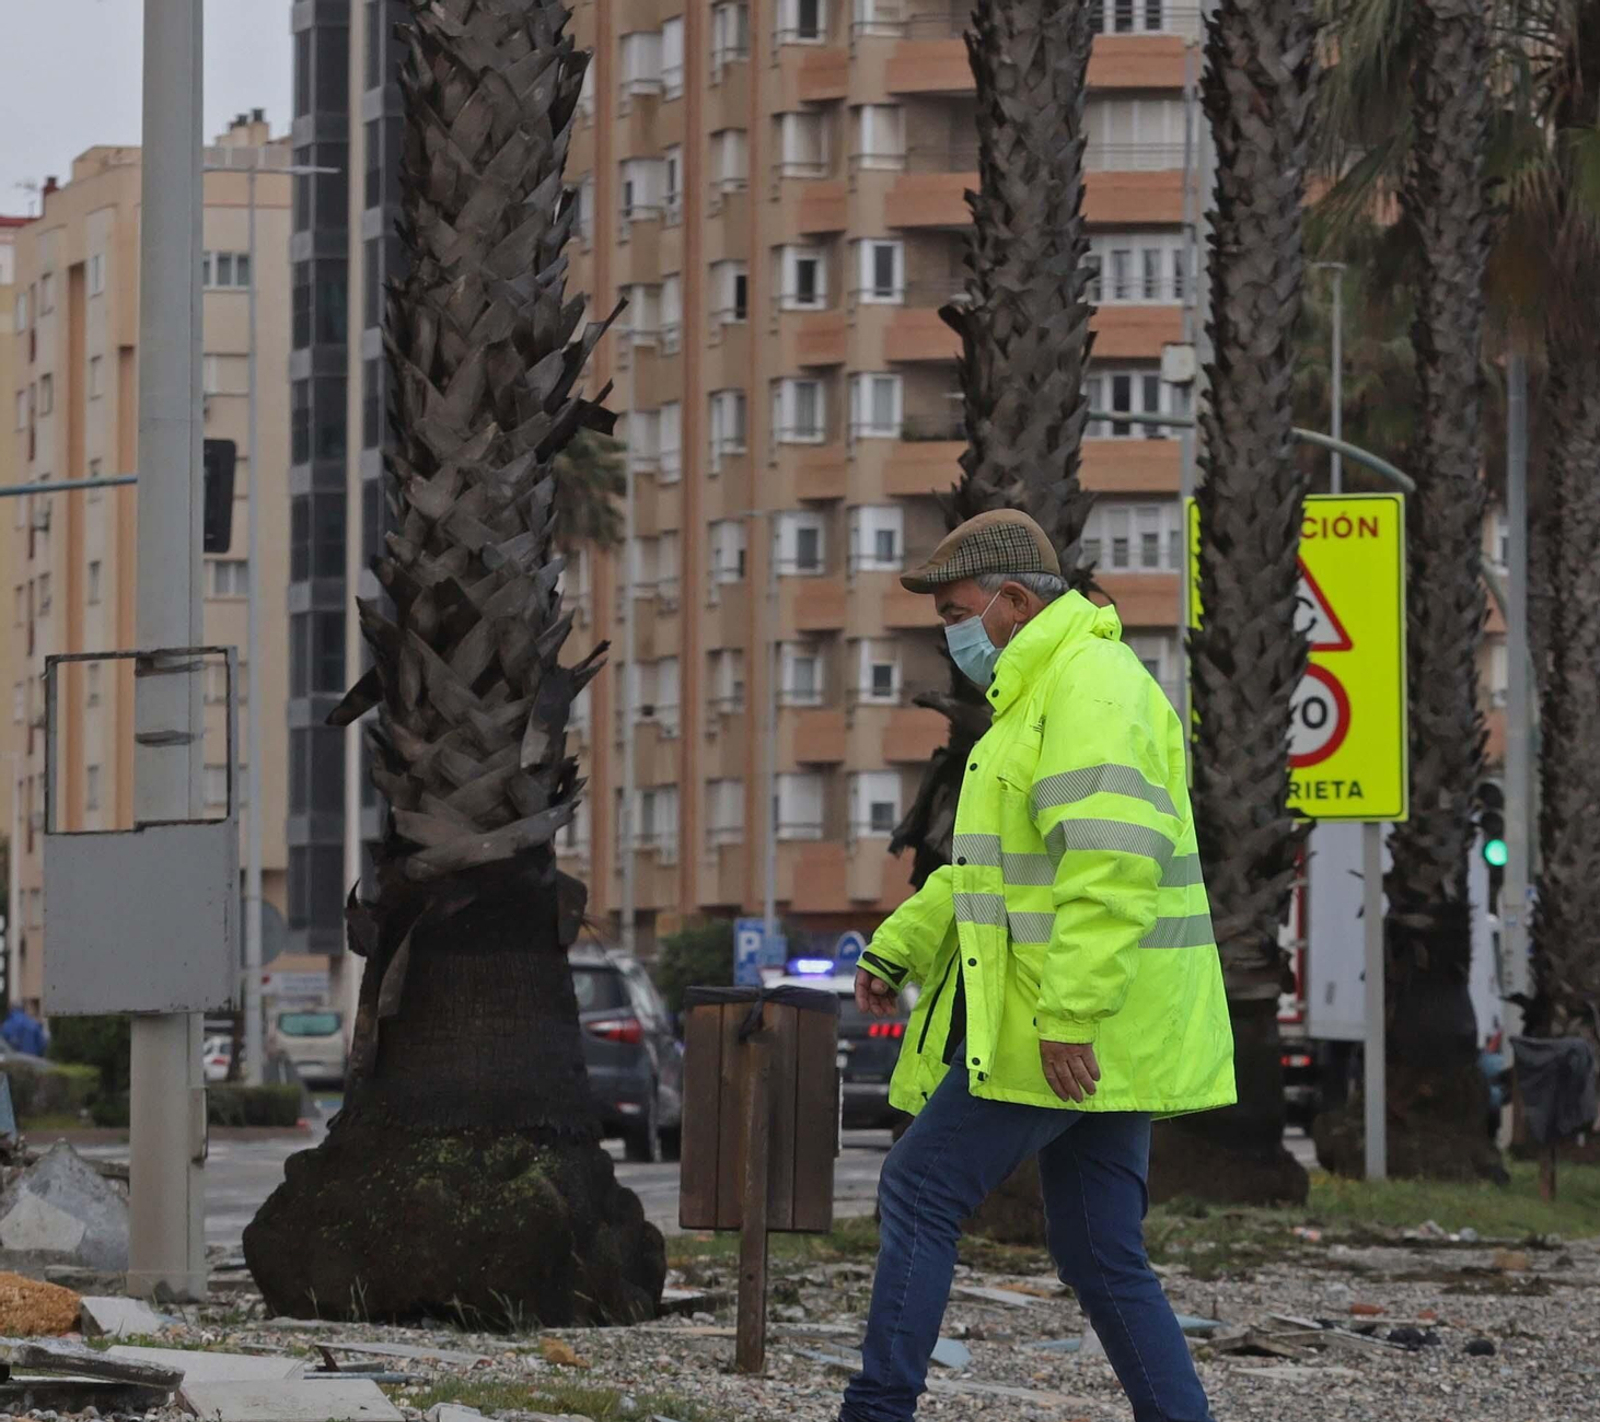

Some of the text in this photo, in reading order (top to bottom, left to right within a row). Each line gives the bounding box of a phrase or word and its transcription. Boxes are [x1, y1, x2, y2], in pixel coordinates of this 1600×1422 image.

[1300, 511, 1378, 539] CIÓN
[1302, 696, 1328, 730] 0
[1289, 781, 1364, 799] RIETA
[738, 931, 762, 962] P
